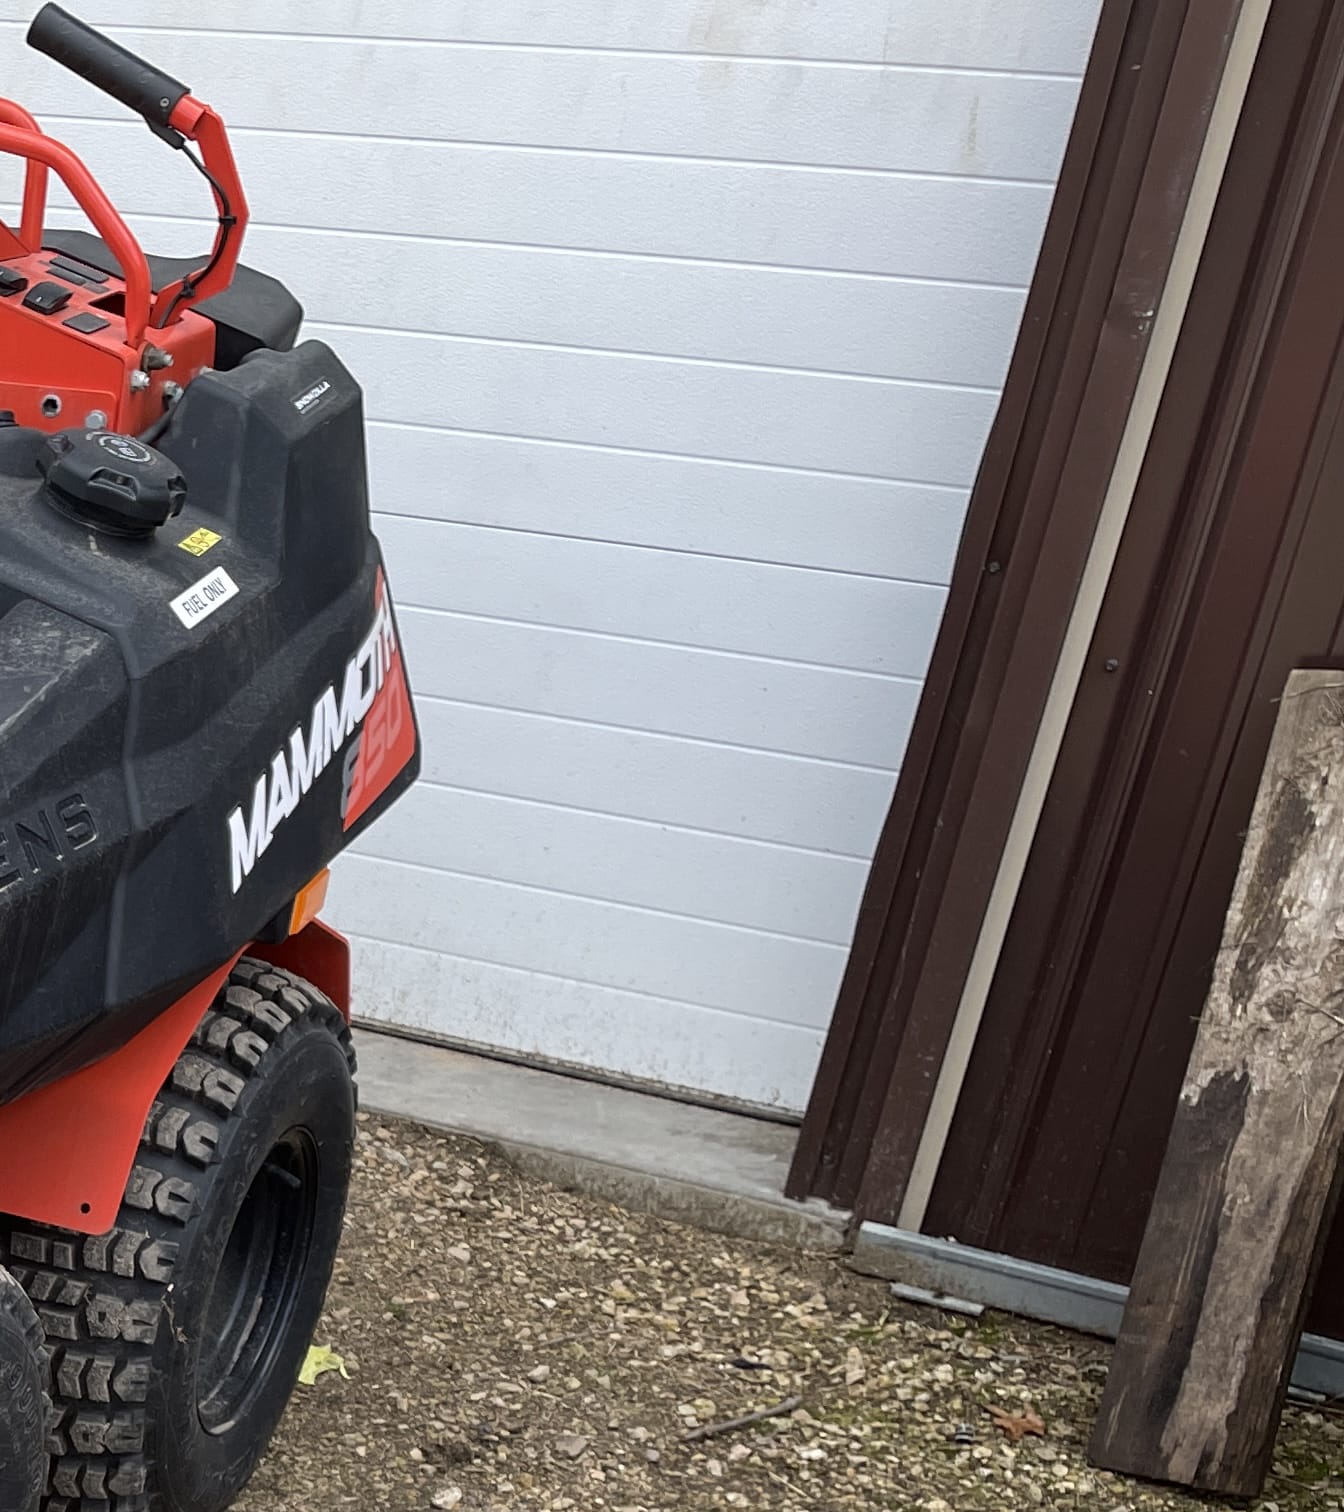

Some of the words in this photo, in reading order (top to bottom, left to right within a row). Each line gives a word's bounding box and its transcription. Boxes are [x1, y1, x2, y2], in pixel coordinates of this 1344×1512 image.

[182, 594, 208, 617] FUEL
[202, 577, 227, 601] ONLY
[228, 581, 396, 894] MAMMOTH
